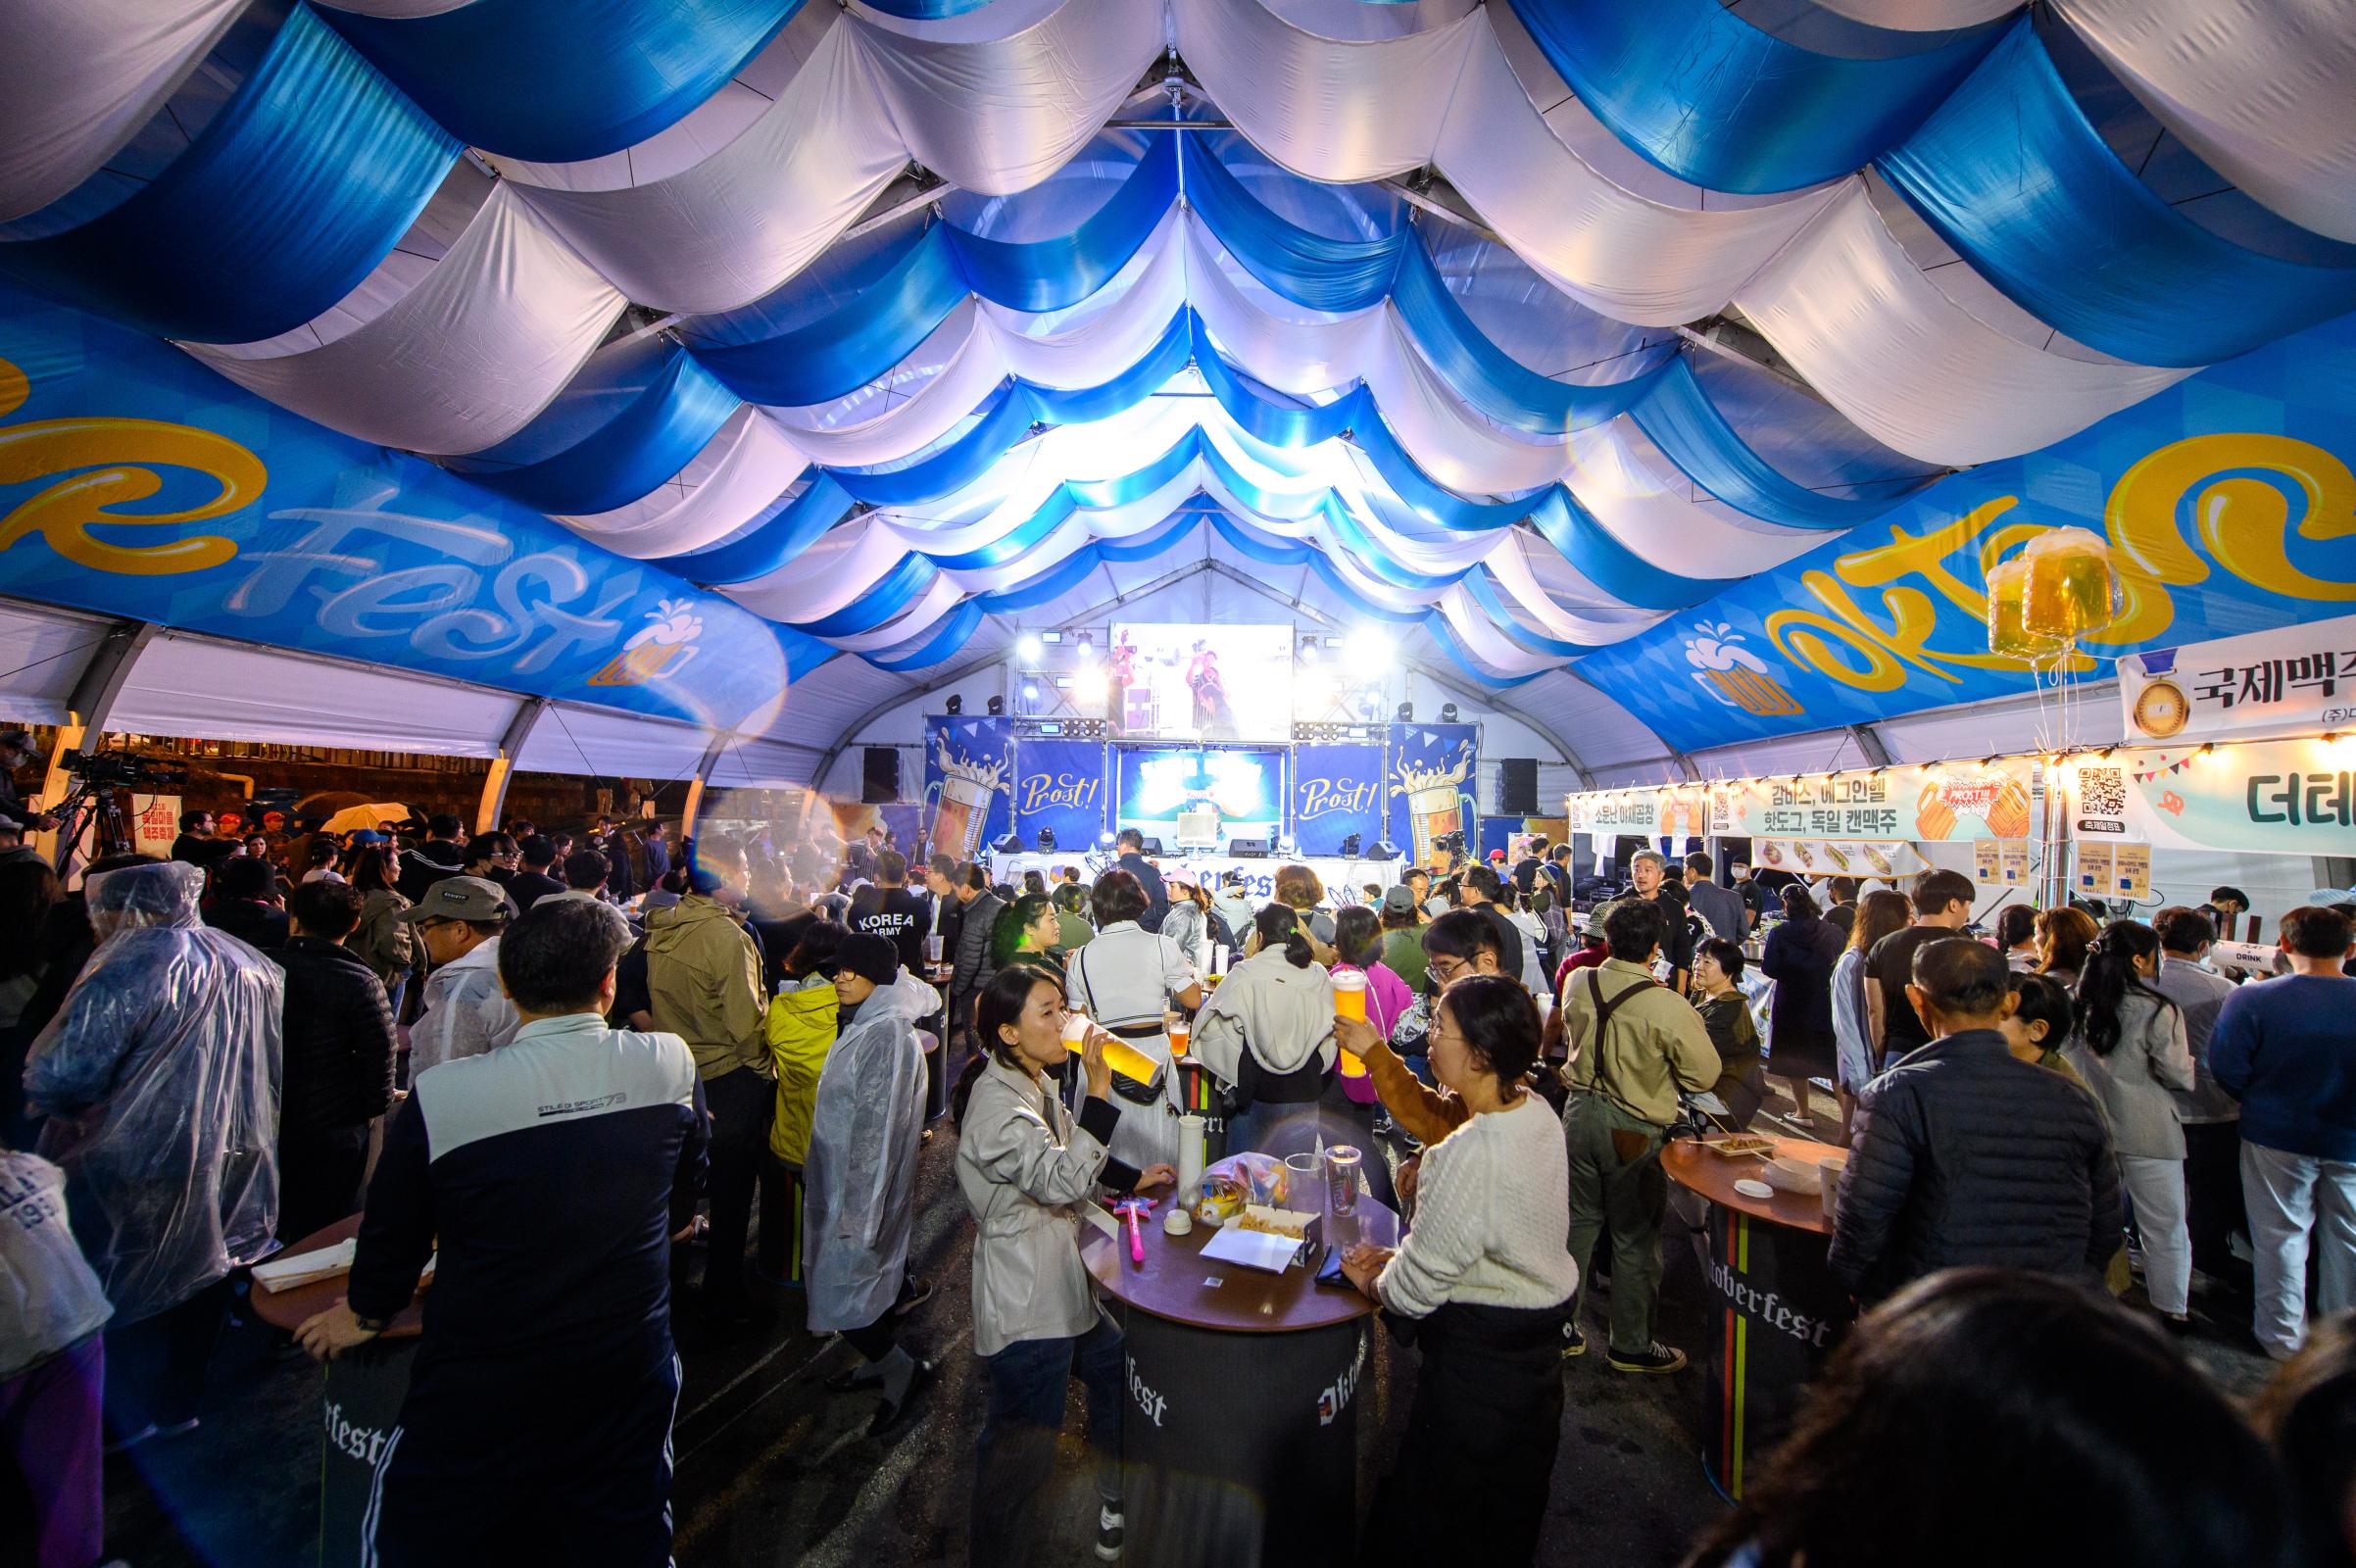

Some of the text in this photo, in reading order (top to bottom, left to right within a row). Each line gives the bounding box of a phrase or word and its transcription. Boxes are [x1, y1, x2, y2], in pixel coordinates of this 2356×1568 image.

[1020, 773, 1099, 815] Prost!
[1299, 778, 1378, 819] Prost!
[1772, 778, 1886, 806] 감바스, 에그인헬
[1949, 788, 1990, 802] PROST!!!
[1595, 803, 1617, 824] 소문난
[1620, 802, 1654, 825] 야채곱창
[1764, 808, 1897, 834] 핫도그, 독일 캔맥주
[859, 913, 913, 931] KOREA
[872, 926, 902, 936] ARMY
[2236, 953, 2262, 962] DRINK
[574, 1097, 605, 1107] SPORT
